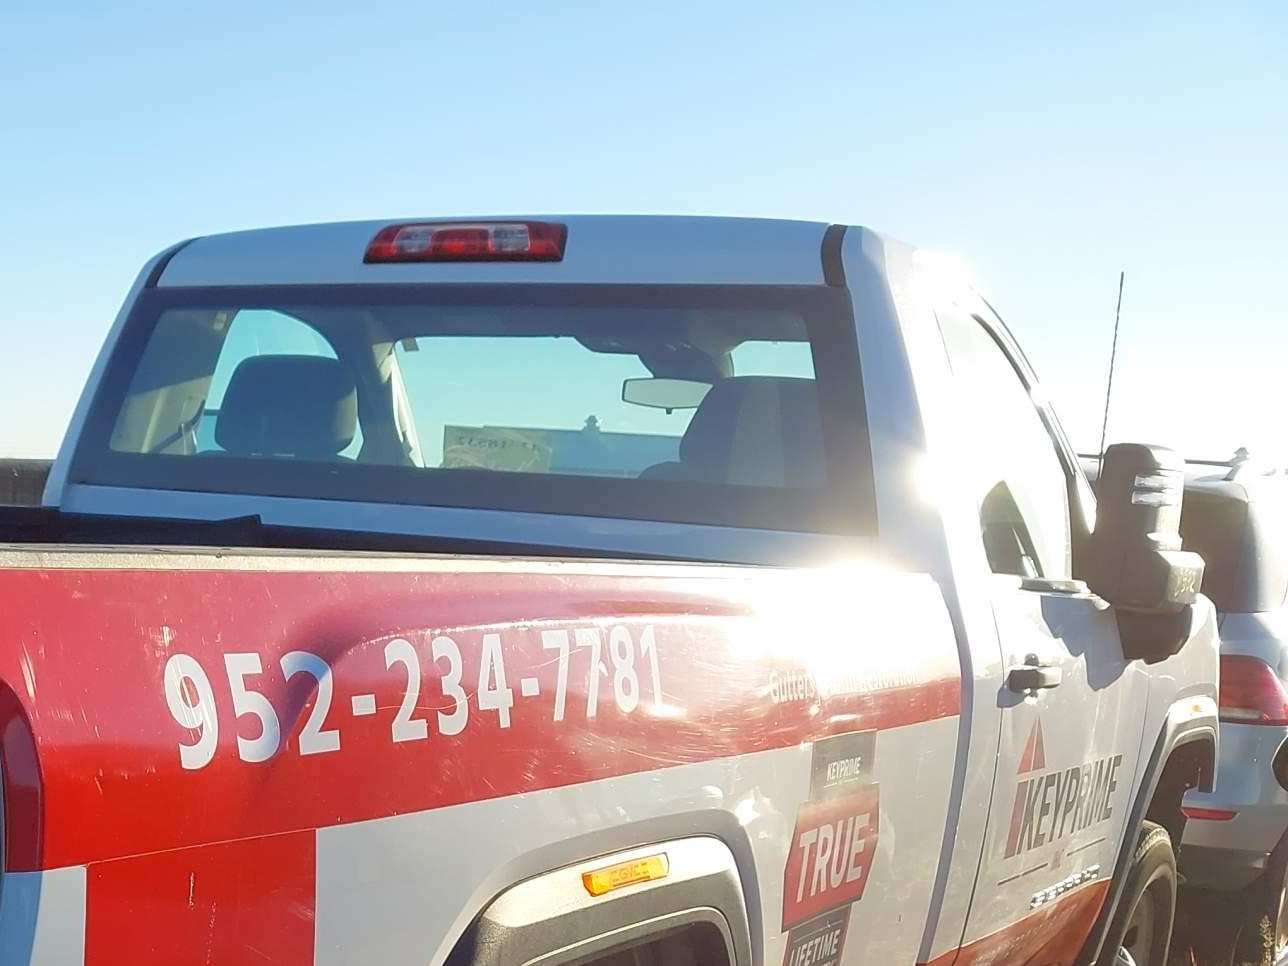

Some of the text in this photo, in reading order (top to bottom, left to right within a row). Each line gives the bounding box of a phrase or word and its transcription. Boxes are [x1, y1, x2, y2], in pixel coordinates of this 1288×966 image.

[164, 624, 663, 770] 952-234-7781
[1016, 753, 1124, 856] KEYPRIME
[795, 813, 870, 903] TRUE
